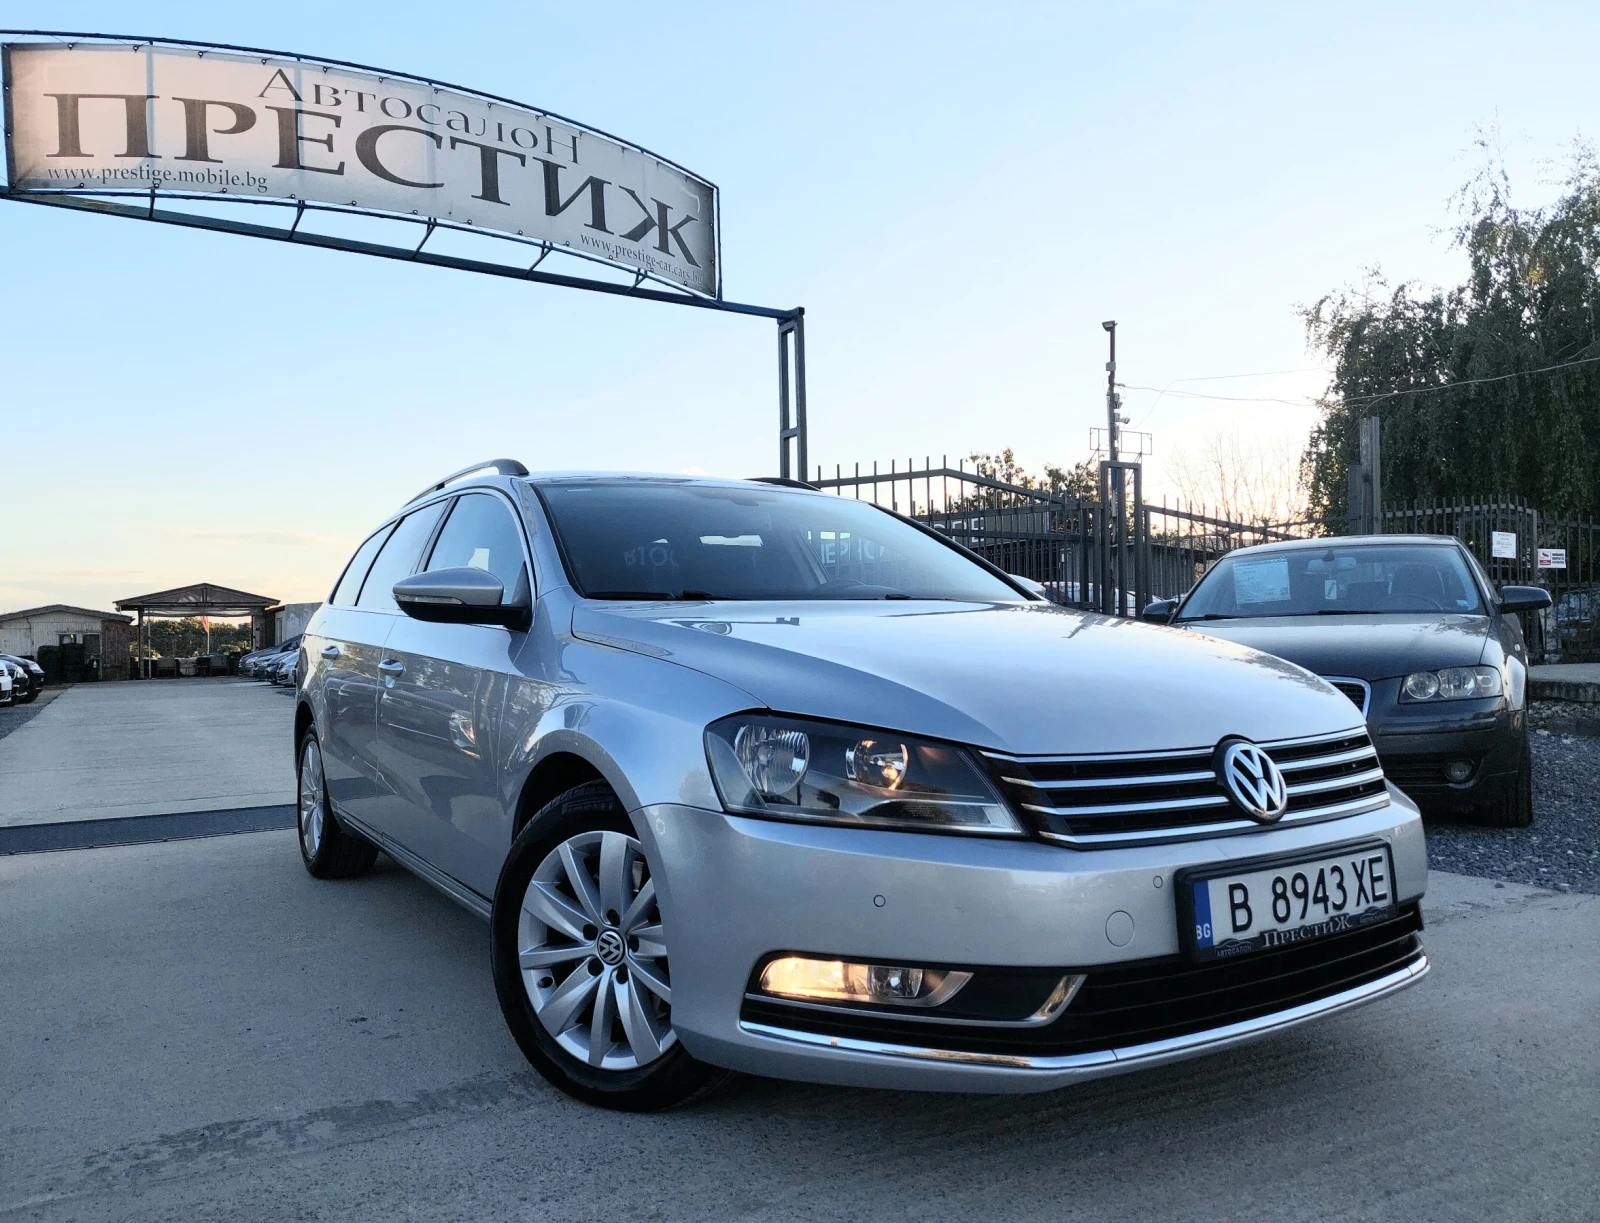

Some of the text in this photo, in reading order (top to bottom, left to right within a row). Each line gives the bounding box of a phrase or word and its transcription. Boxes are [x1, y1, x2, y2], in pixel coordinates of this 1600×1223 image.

[43, 92, 702, 269] ПРЕСТИЖ
[47, 164, 269, 194] www.prestige.mobile.bg
[579, 233, 703, 287] www.prestige-car.cars.bg
[1228, 854, 1388, 934] B 8943 XE
[1195, 922, 1211, 940] BG
